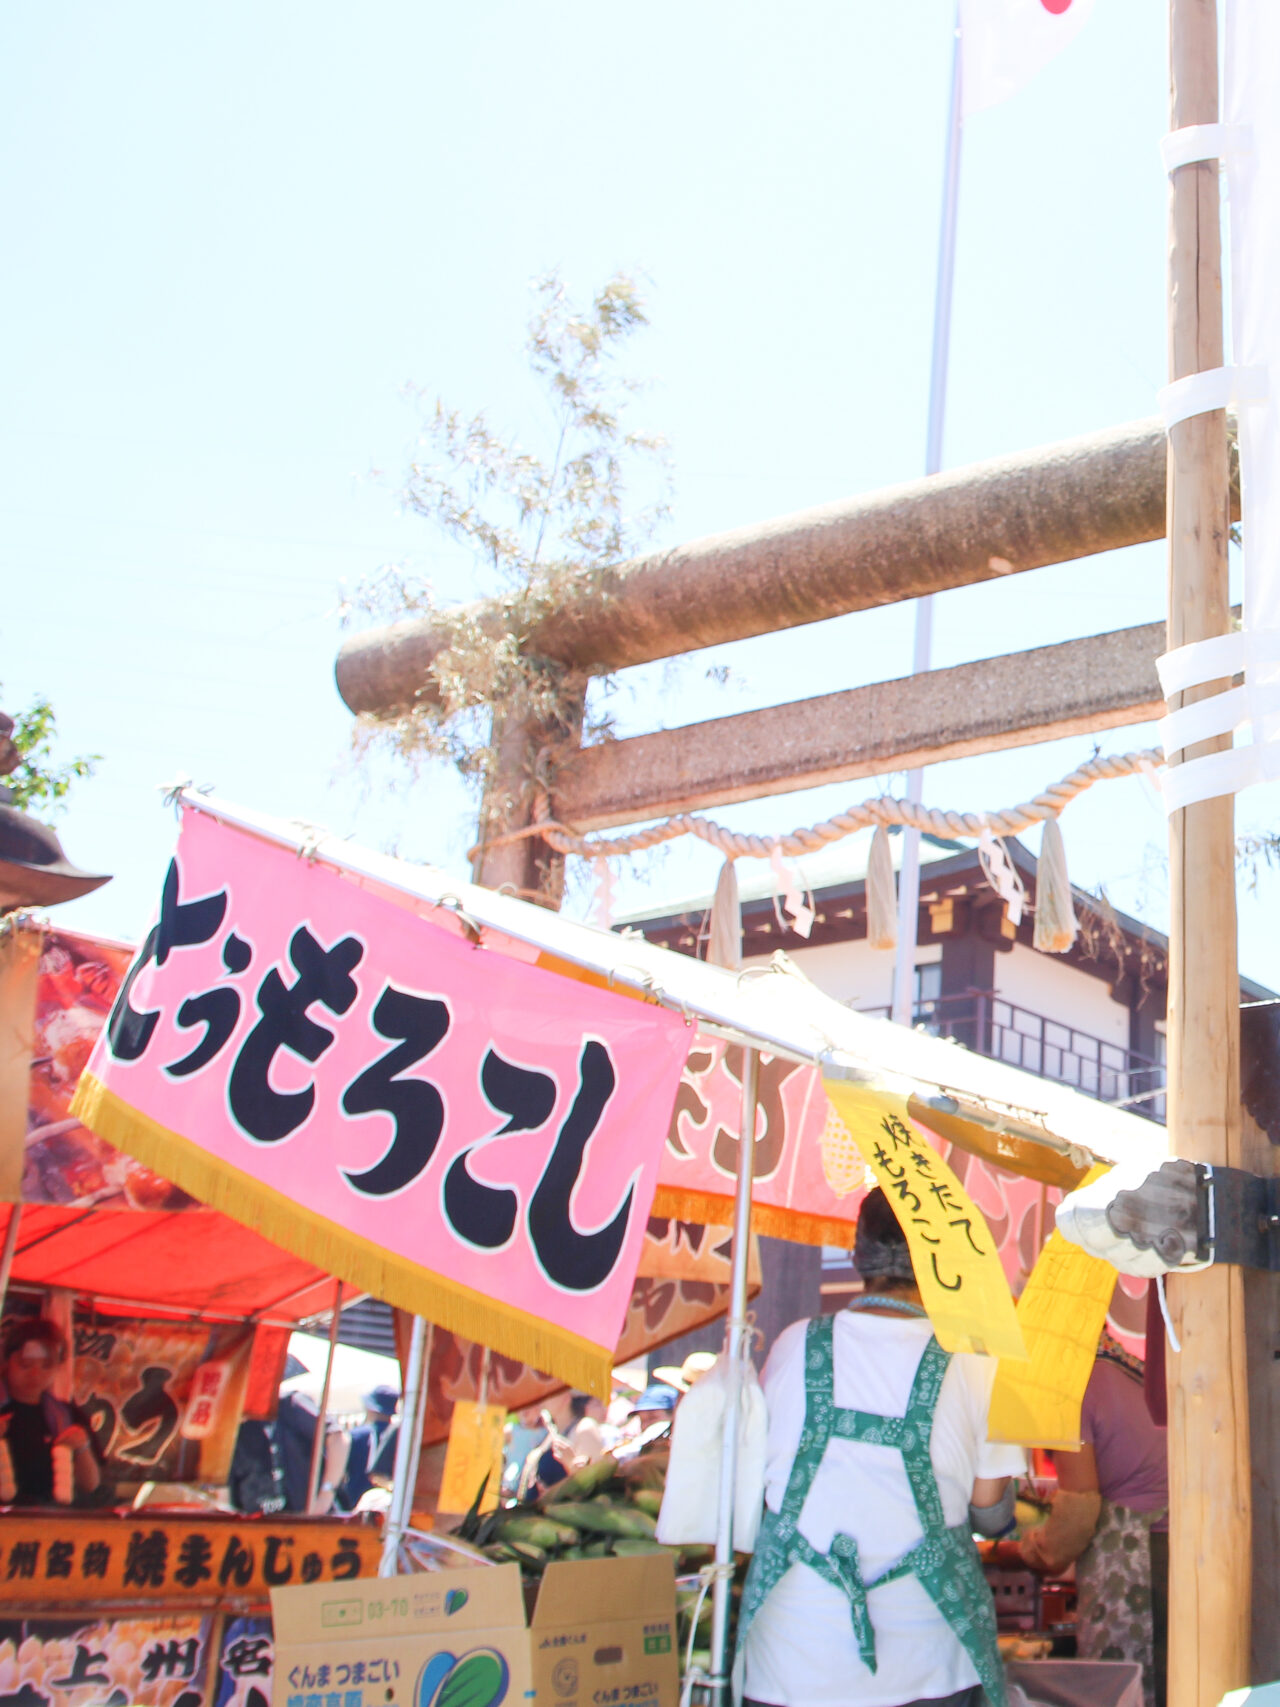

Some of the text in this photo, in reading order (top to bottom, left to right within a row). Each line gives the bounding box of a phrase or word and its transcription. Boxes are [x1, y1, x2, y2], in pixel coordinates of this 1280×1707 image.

[107, 856, 638, 1290] とうもろこし
[873, 1141, 962, 1291] もろこし
[880, 1113, 986, 1256] 焼きたて
[0, 1530, 363, 1588] 州名物 焼まんじゅう
